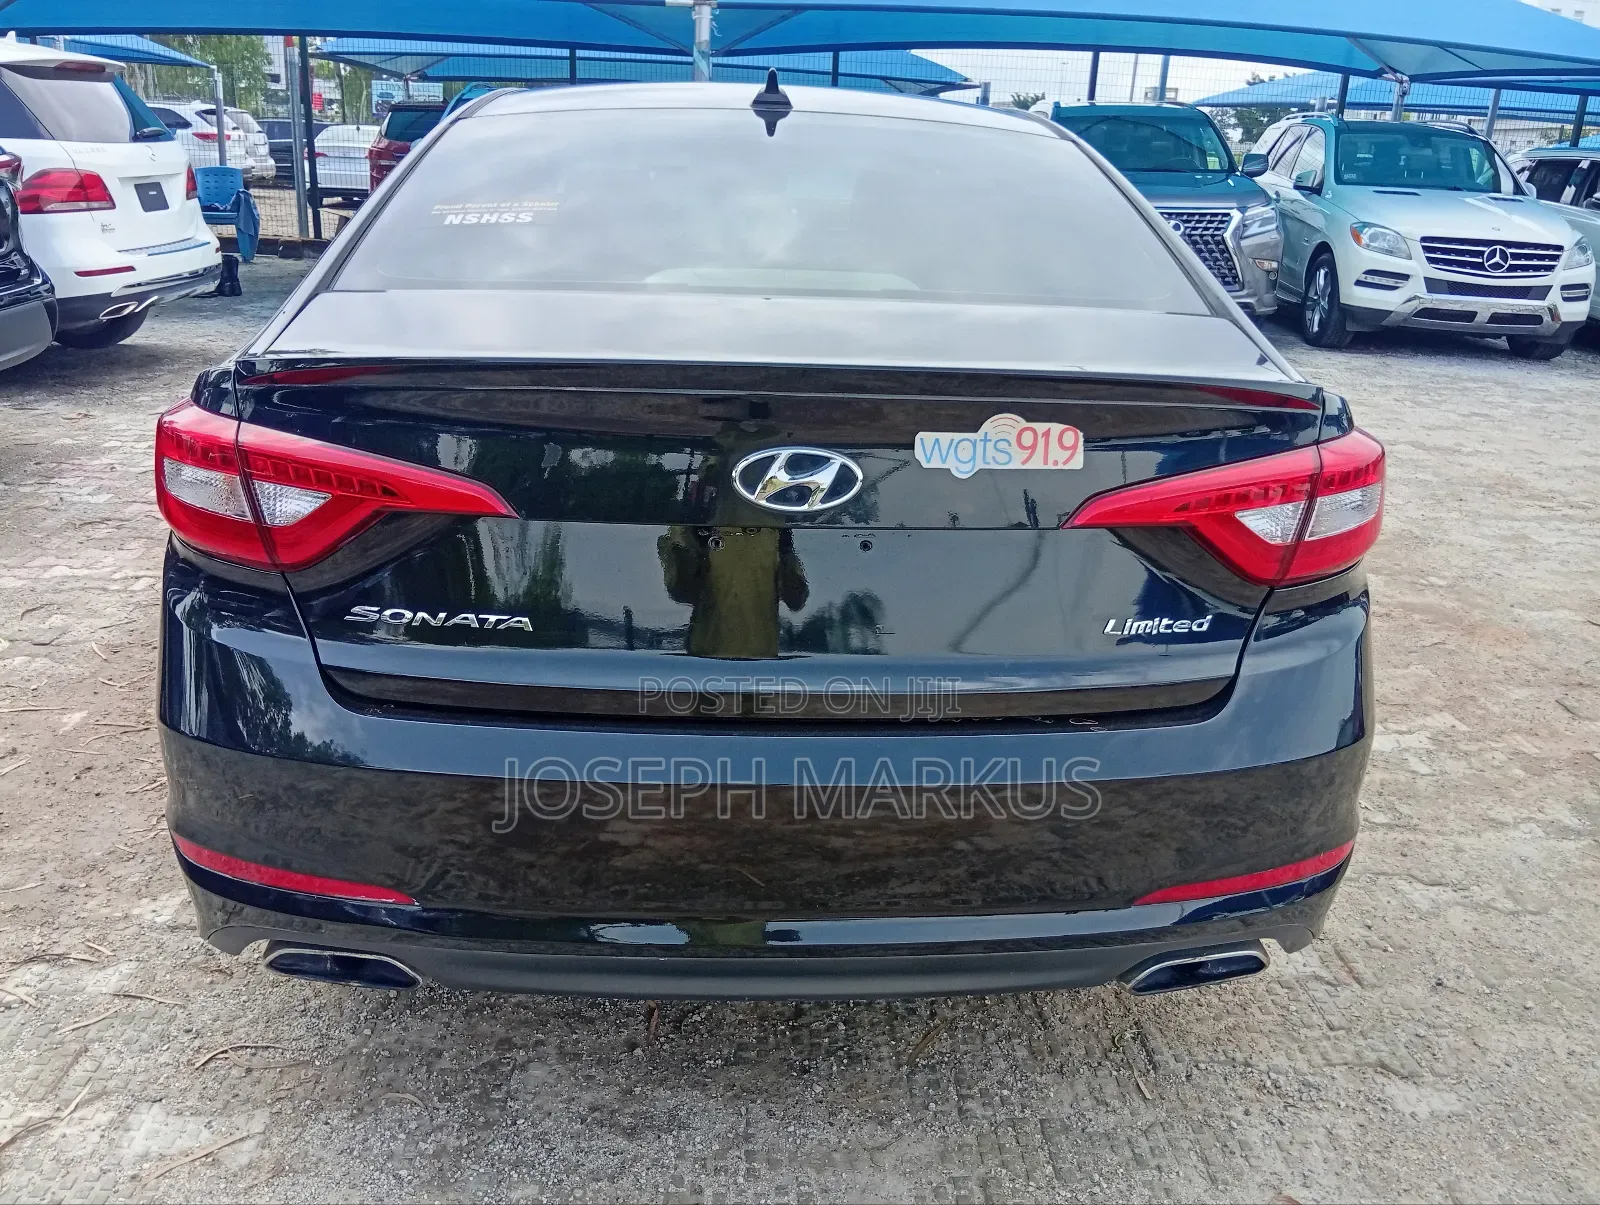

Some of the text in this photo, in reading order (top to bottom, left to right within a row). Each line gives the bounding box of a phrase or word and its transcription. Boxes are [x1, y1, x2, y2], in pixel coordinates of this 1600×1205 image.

[443, 212, 534, 225] NSHSS
[343, 605, 534, 632] SONATA
[1103, 615, 1213, 635] Limited
